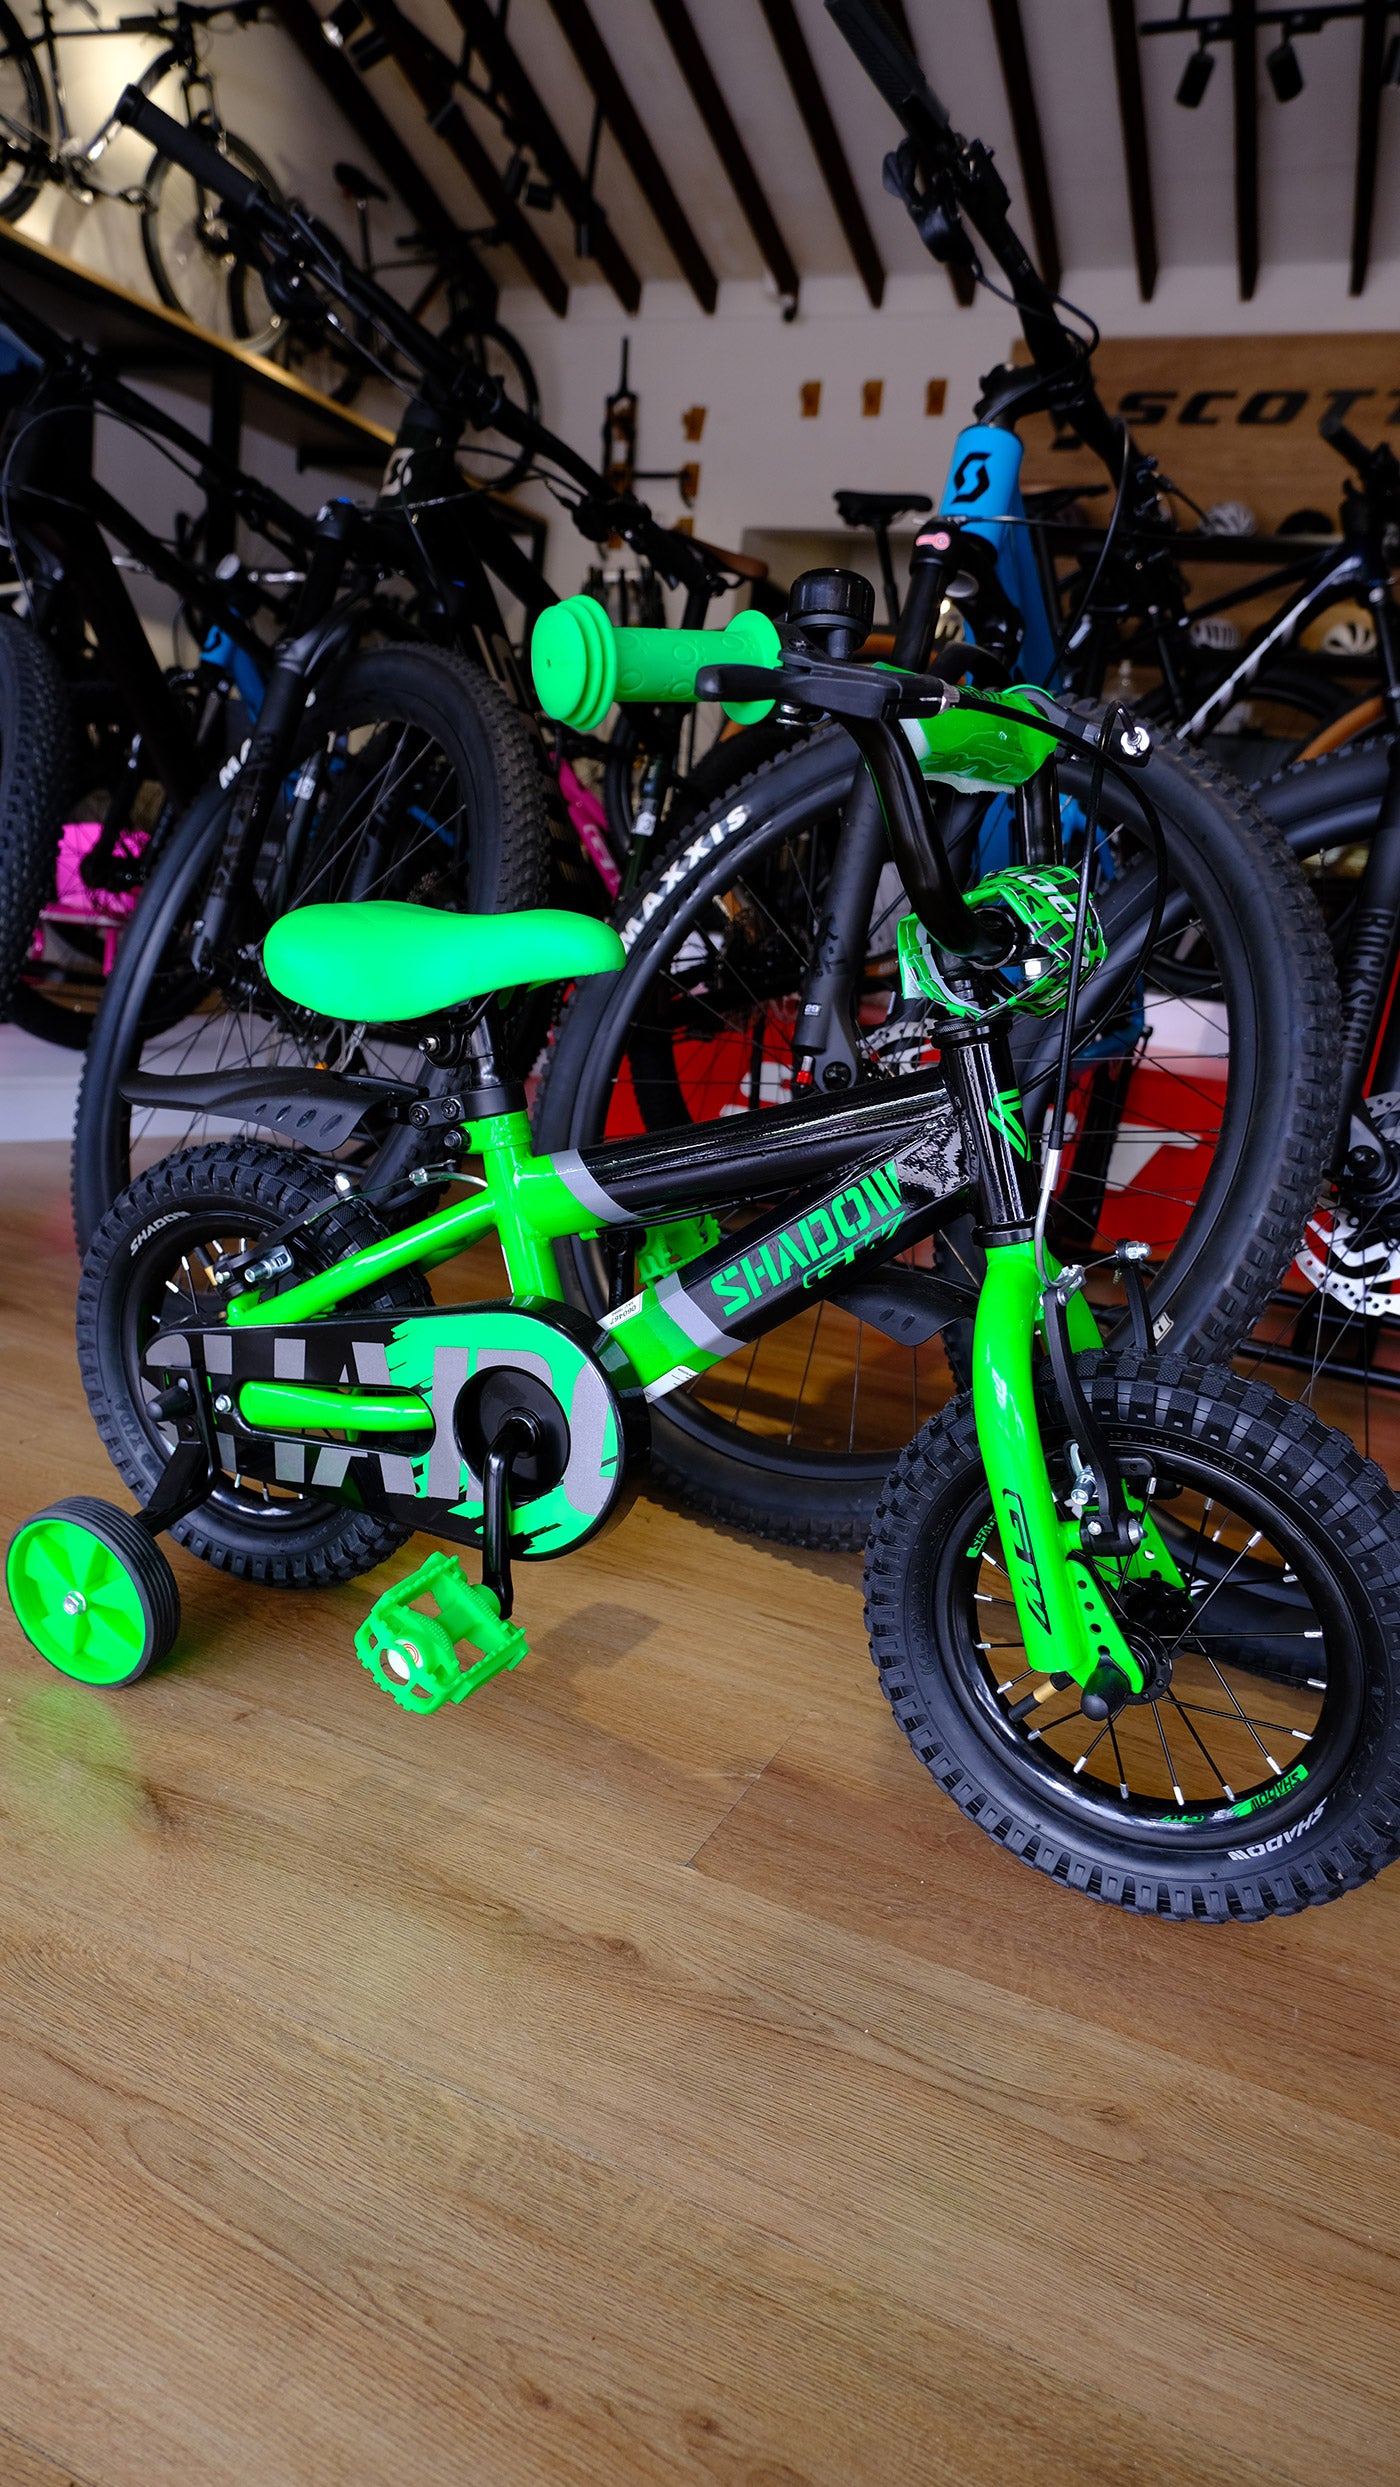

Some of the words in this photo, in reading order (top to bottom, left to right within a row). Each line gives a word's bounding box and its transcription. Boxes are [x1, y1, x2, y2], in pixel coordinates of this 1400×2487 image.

[620, 804, 751, 954] MAXXIS
[130, 1210, 191, 1256] SHADOW
[710, 1161, 902, 1317] SHADOW
[1227, 1797, 1328, 1861] SHADOW
